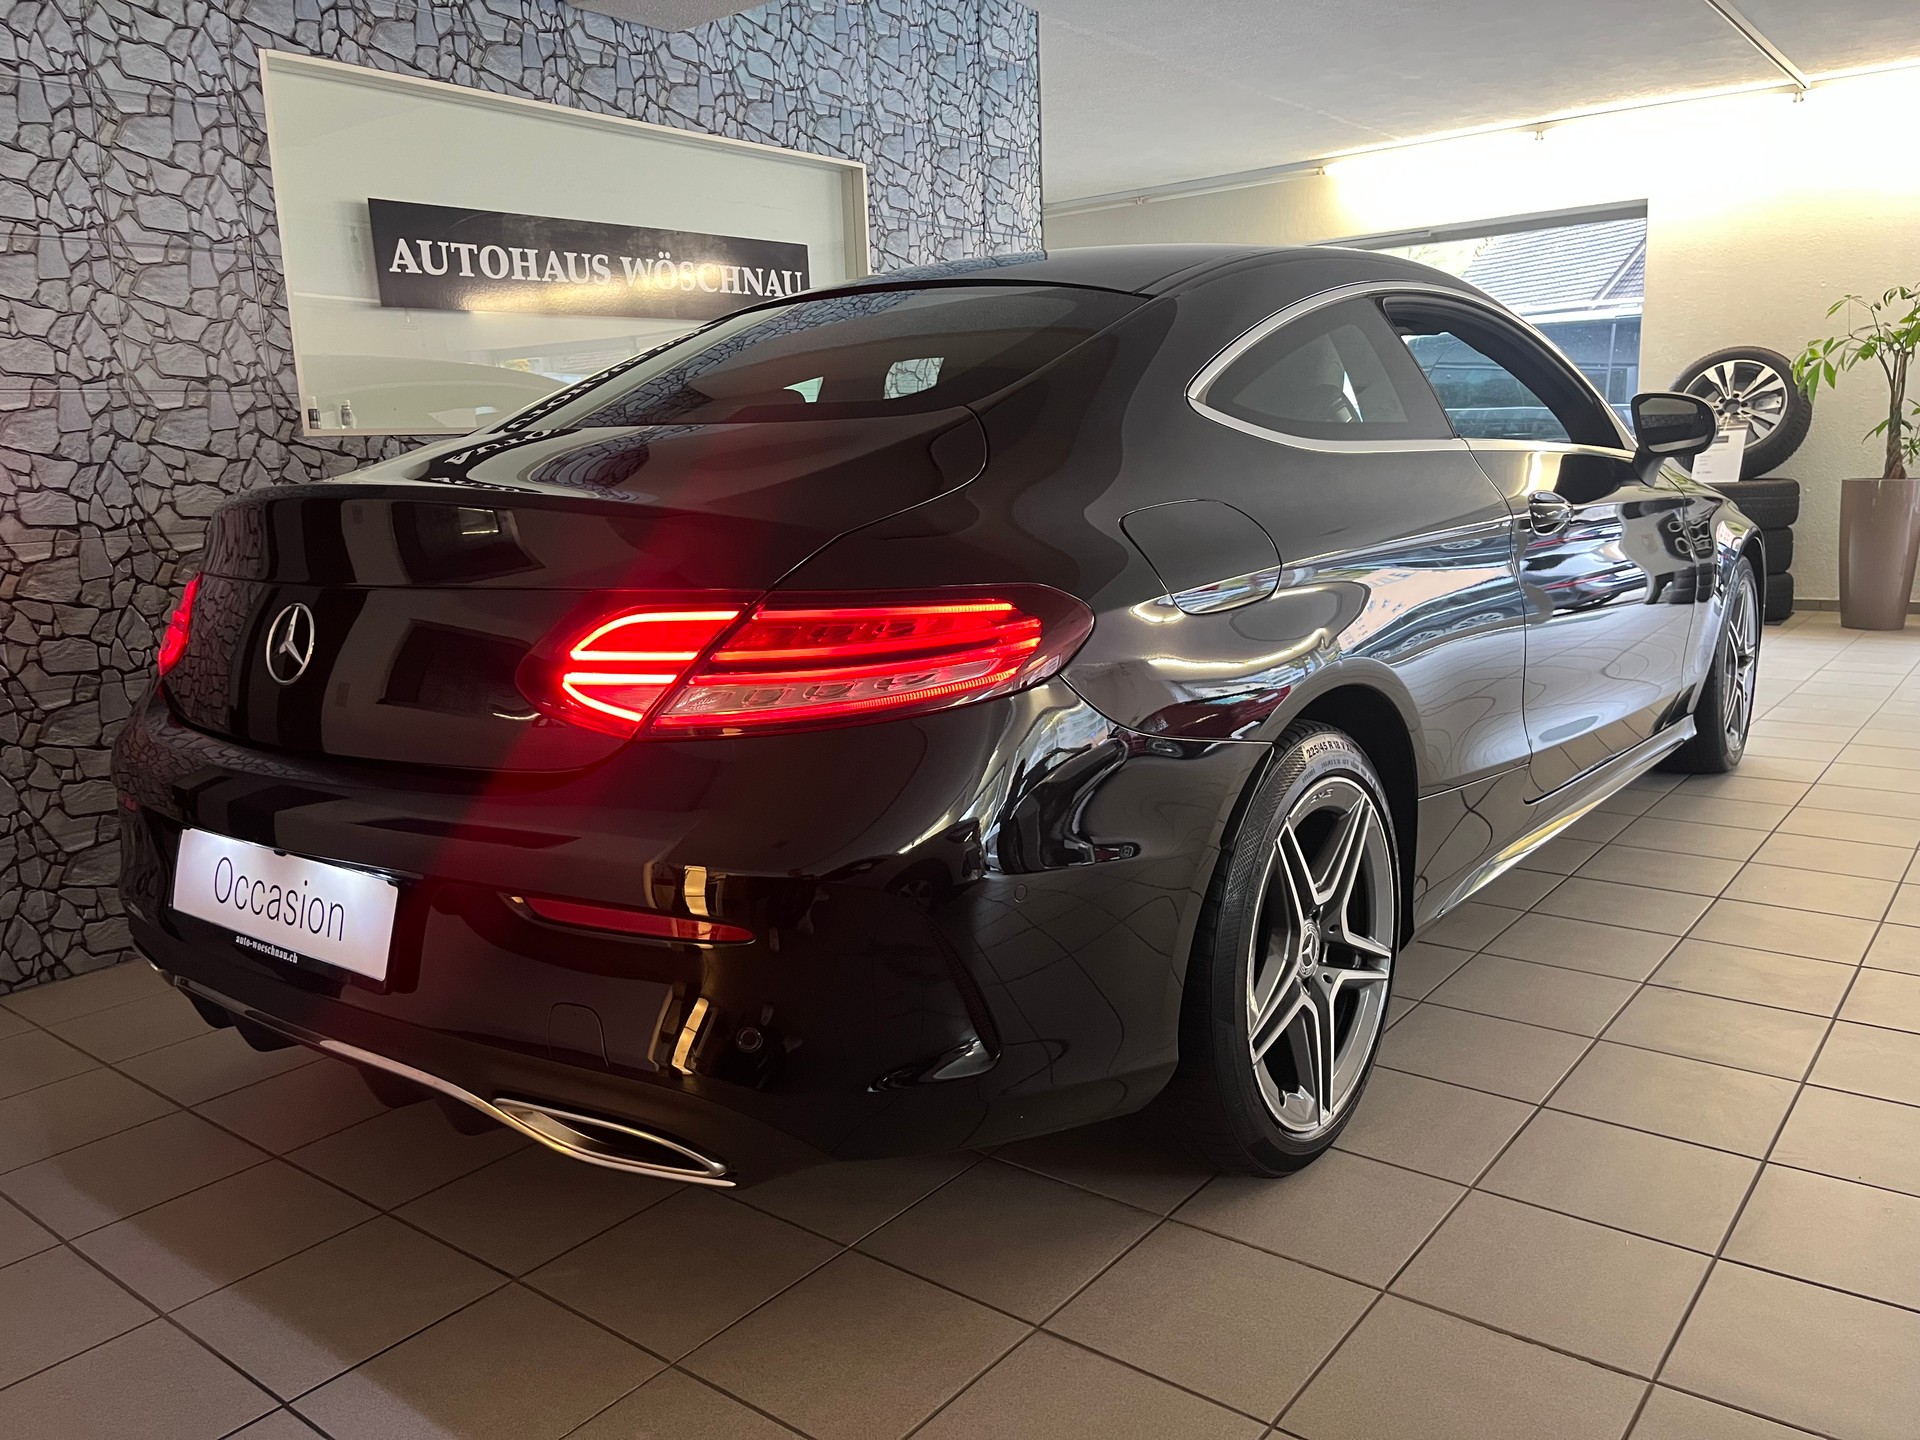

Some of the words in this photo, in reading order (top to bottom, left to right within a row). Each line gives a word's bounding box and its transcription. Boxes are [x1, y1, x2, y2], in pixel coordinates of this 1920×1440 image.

[389, 238, 612, 286] AUTOHAUS
[619, 252, 803, 298] WÖSCHNAU
[214, 856, 345, 942] Occasion
[235, 935, 298, 964] auto-woeschnau.ch
